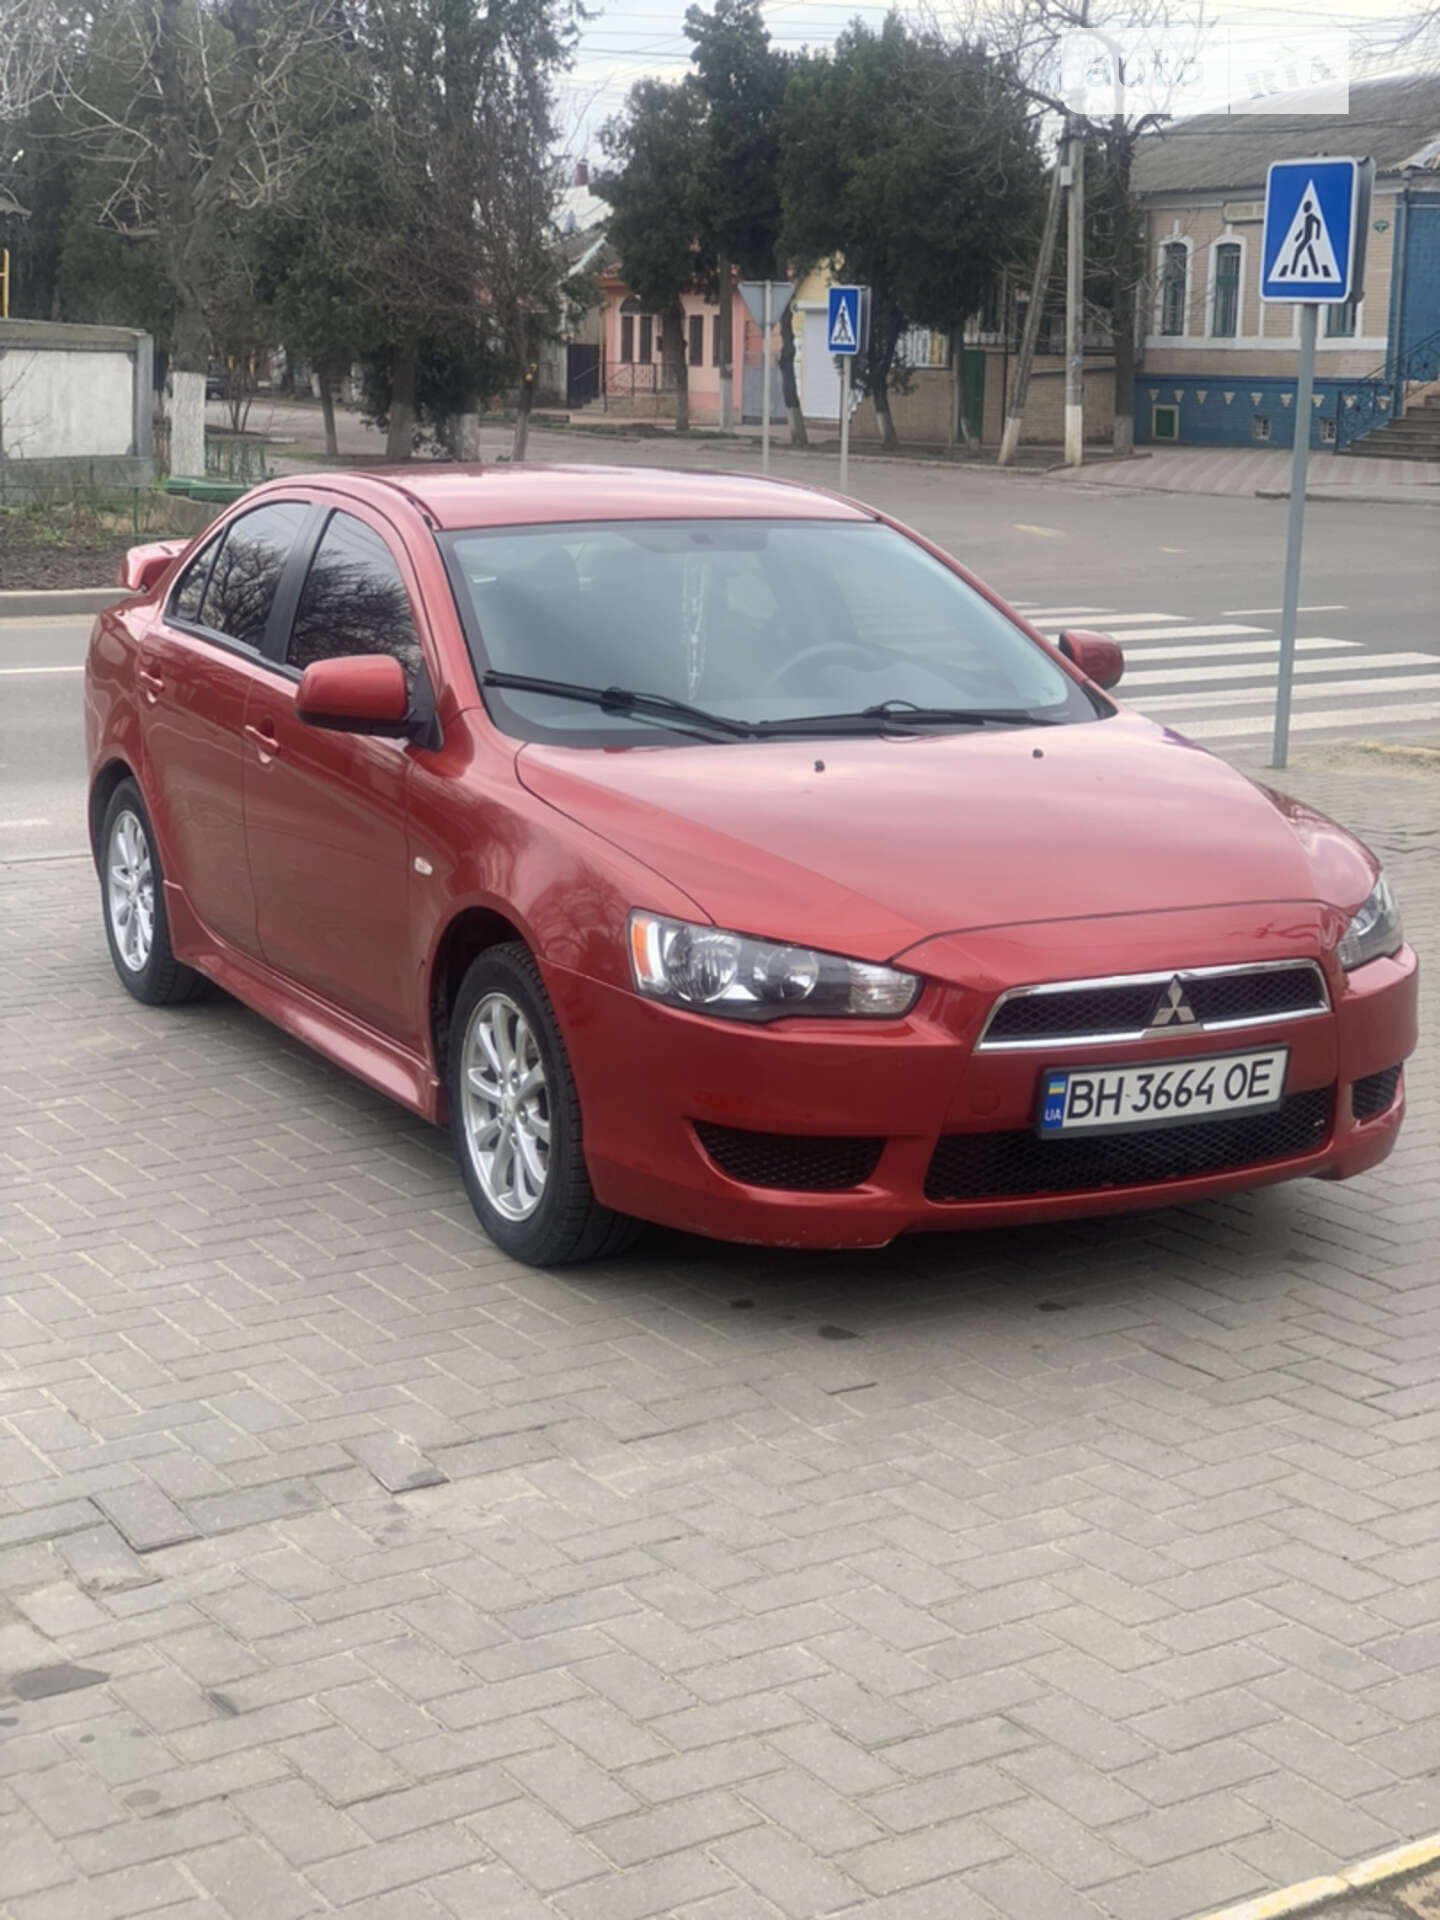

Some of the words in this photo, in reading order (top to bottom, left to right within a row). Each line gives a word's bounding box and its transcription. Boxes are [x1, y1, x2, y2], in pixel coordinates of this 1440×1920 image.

[1066, 1076, 1125, 1119] BH
[1131, 1066, 1216, 1113] 3664
[1223, 1058, 1274, 1101] OE
[1044, 1108, 1062, 1122] UA
